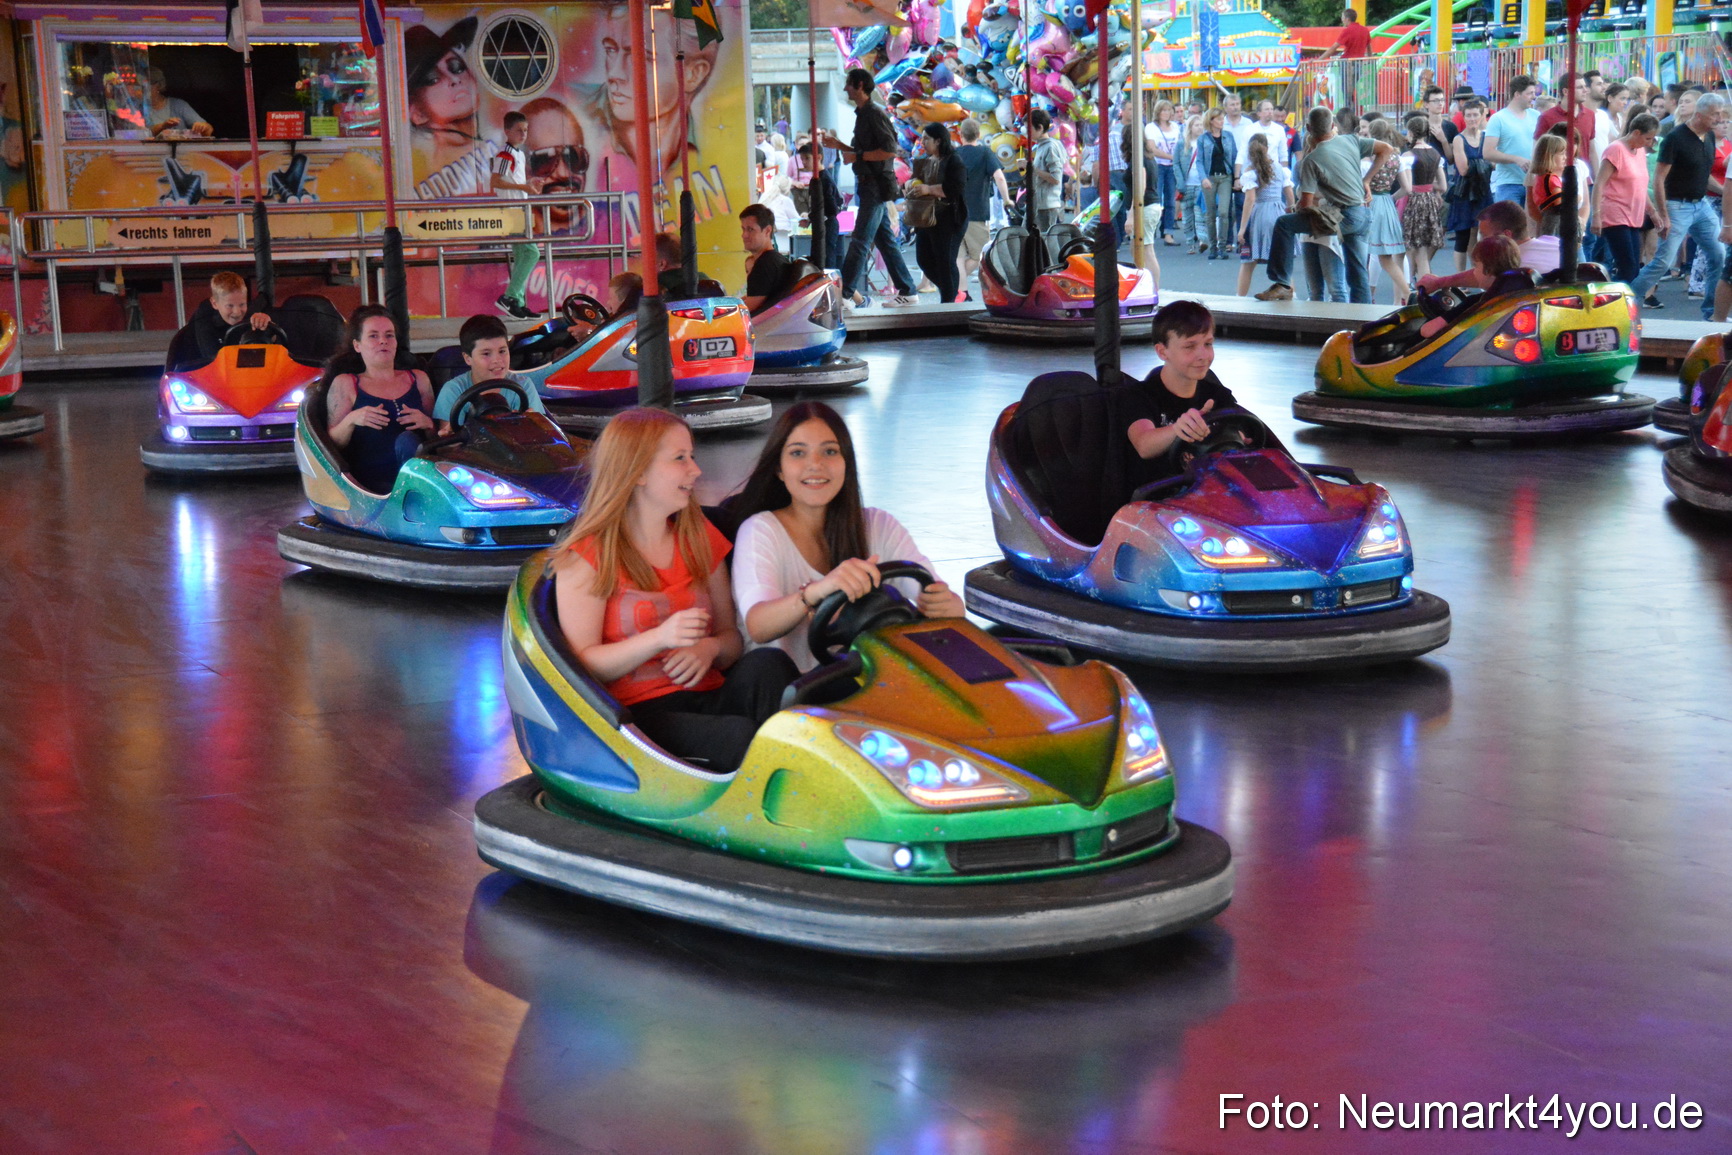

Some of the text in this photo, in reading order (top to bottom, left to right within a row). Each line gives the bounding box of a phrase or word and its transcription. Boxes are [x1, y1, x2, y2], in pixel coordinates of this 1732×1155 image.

[1220, 47, 1294, 65] TWISTER
[271, 112, 300, 121] Fahrpreis
[413, 139, 501, 200] ADONNA
[428, 218, 503, 231] rechts fahren
[129, 226, 212, 240] rechts fahren
[527, 266, 599, 303] ONDER
[706, 341, 728, 352] 07
